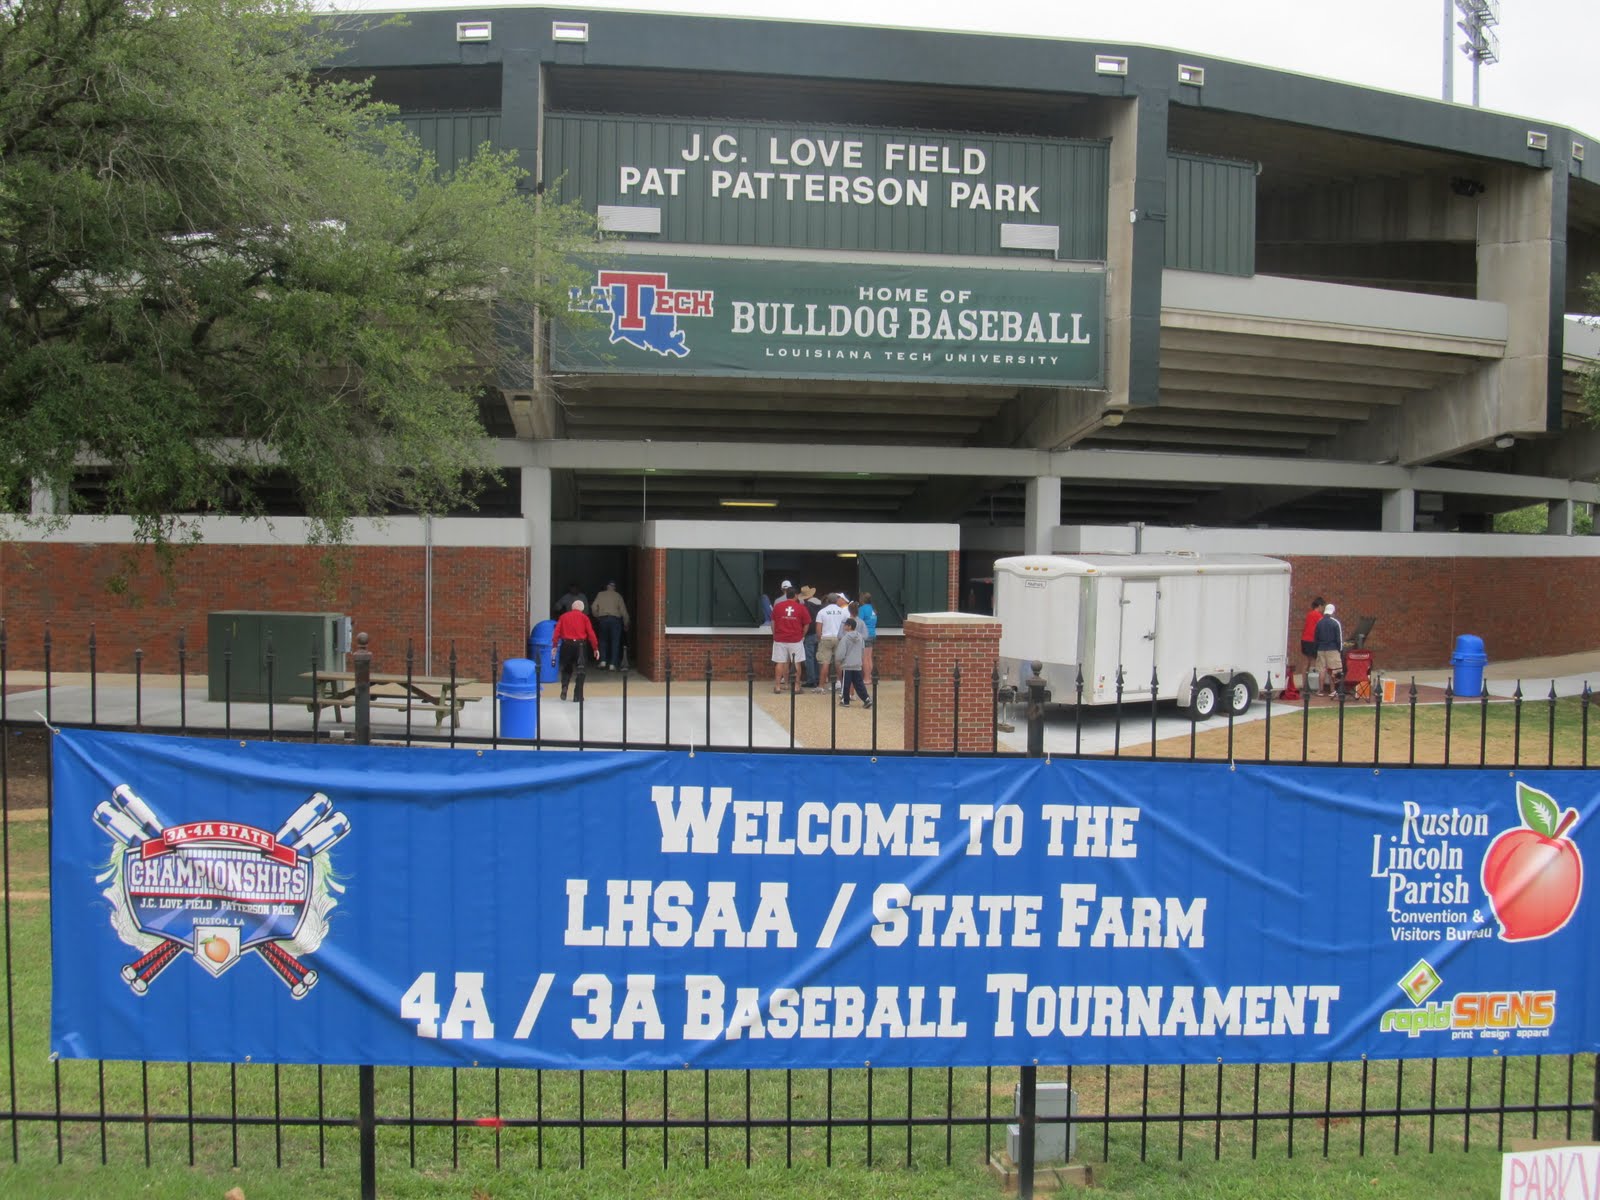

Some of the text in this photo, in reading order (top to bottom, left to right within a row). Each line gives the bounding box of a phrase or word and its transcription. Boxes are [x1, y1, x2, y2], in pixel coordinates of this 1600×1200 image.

[681, 134, 986, 175] J.C. LOVE FIELD
[620, 166, 1040, 213] PAT PATTERSON PARK
[858, 287, 928, 302] HOME
[940, 290, 972, 303] OF
[731, 301, 1090, 344] BULLDOG BASEBALL
[765, 348, 1059, 366] LOUISIANA TECH UNIVERSITY
[166, 825, 269, 846] 3A-4A STATE
[651, 786, 1140, 858] WELCOME TO THE
[1401, 801, 1489, 844] Ruston
[1371, 834, 1463, 878] Lincoln
[130, 857, 305, 895] CHAMPIONSHIPS
[1387, 873, 1470, 912] Parish
[140, 898, 295, 916] J.C. LOVE FIELD PATTERSON PARK
[192, 917, 245, 926] RUSTON, LA
[564, 879, 1207, 948] LHSAA / STATE FARM
[1391, 909, 1485, 923] Convention &
[1391, 927, 1492, 941] Visitors Bureau
[400, 972, 1340, 1040] 4A / 3A BASEBALL TOURNAMENT
[1451, 1028, 1549, 1040] print design apparel
